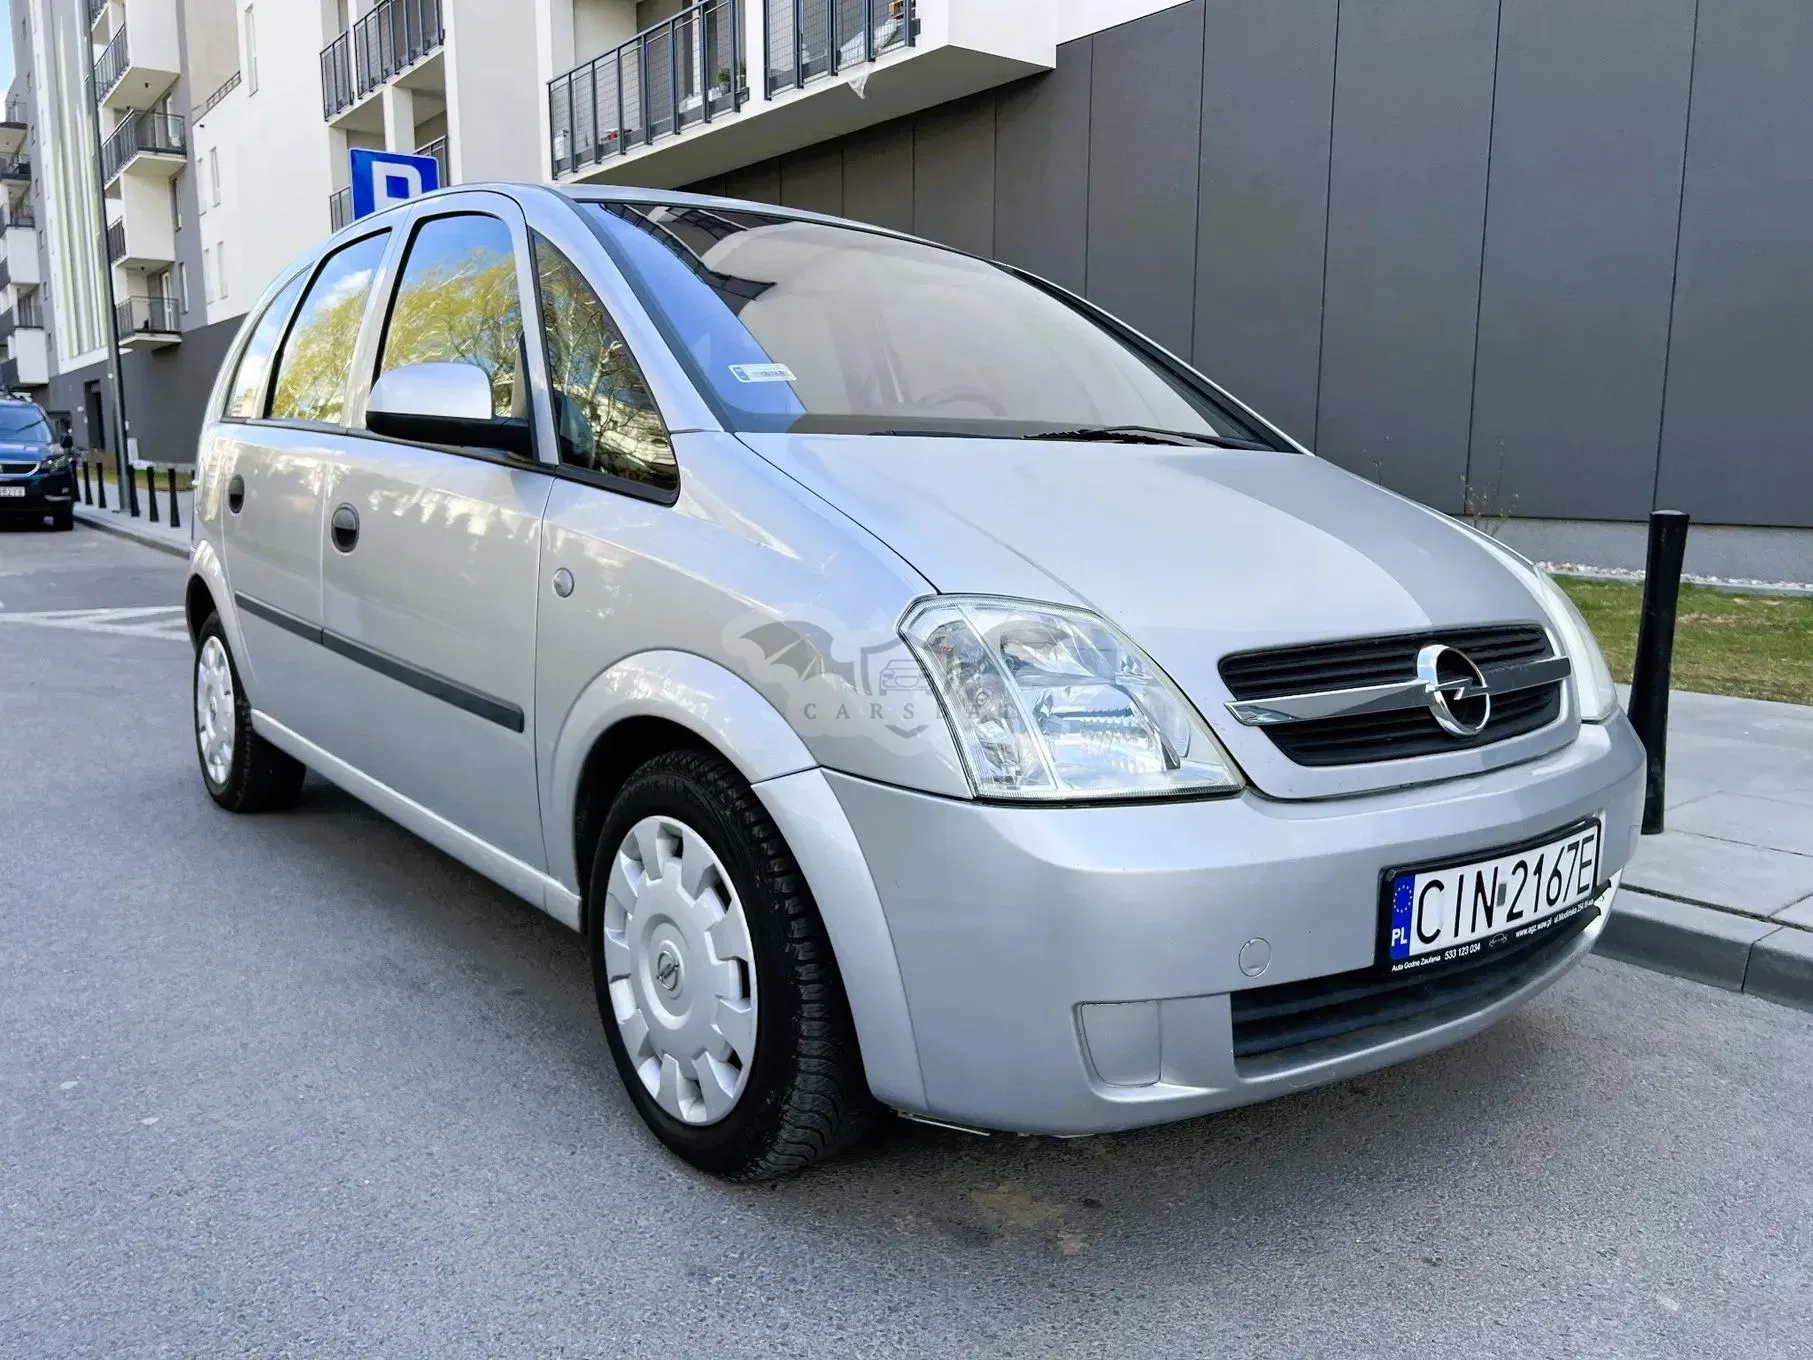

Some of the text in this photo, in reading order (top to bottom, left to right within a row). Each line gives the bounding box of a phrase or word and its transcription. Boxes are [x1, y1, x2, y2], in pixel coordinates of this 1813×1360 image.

[371, 160, 423, 211] P
[1416, 834, 1595, 944] CIN 2167E
[1391, 927, 1407, 946] PL
[1444, 949, 1457, 960] 533
[1458, 945, 1469, 957] 123
[1469, 942, 1481, 954] 034
